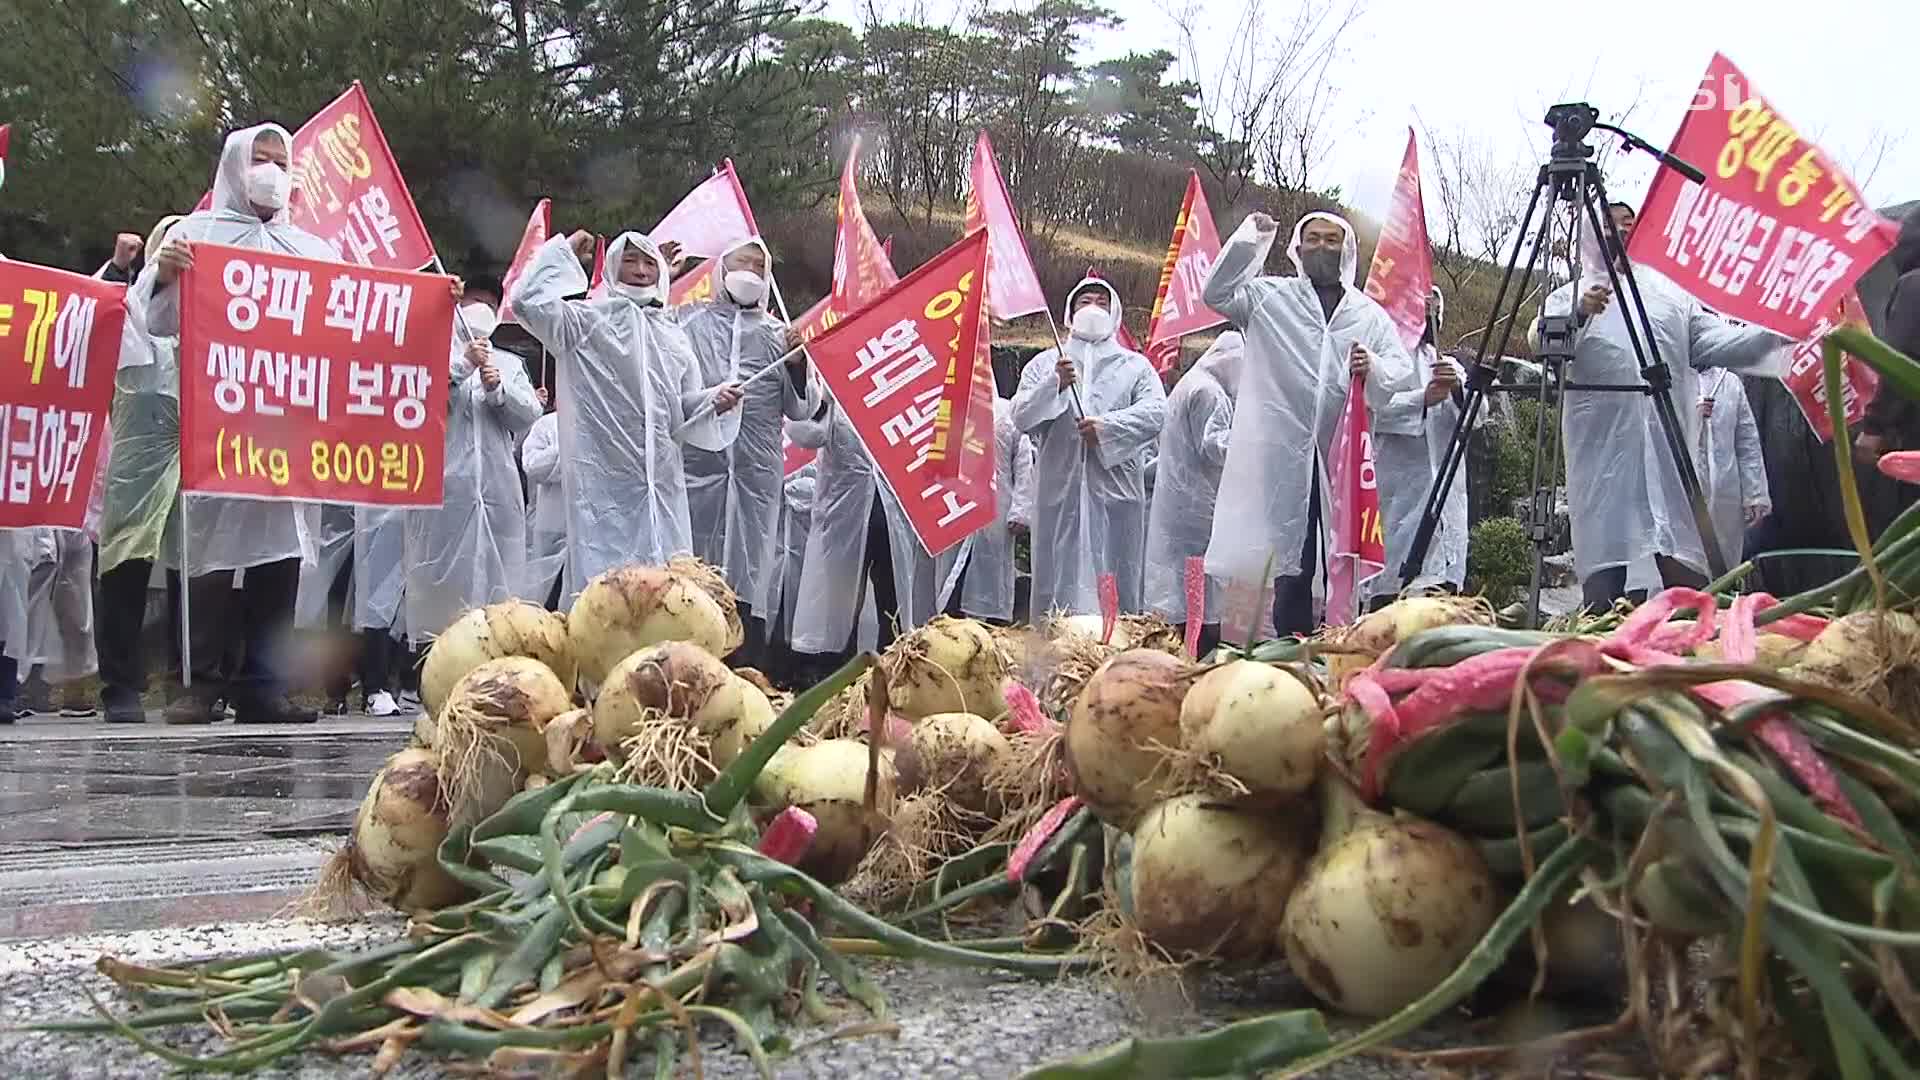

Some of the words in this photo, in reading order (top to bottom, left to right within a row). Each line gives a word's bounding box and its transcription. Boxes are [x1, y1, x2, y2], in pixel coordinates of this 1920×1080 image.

[223, 259, 314, 337] 양파
[325, 274, 413, 348] 최저
[206, 343, 331, 421] 생산비
[346, 361, 433, 429] 보장
[847, 318, 937, 409] 확대
[215, 429, 290, 487] (1kg
[311, 440, 426, 494] 800원)
